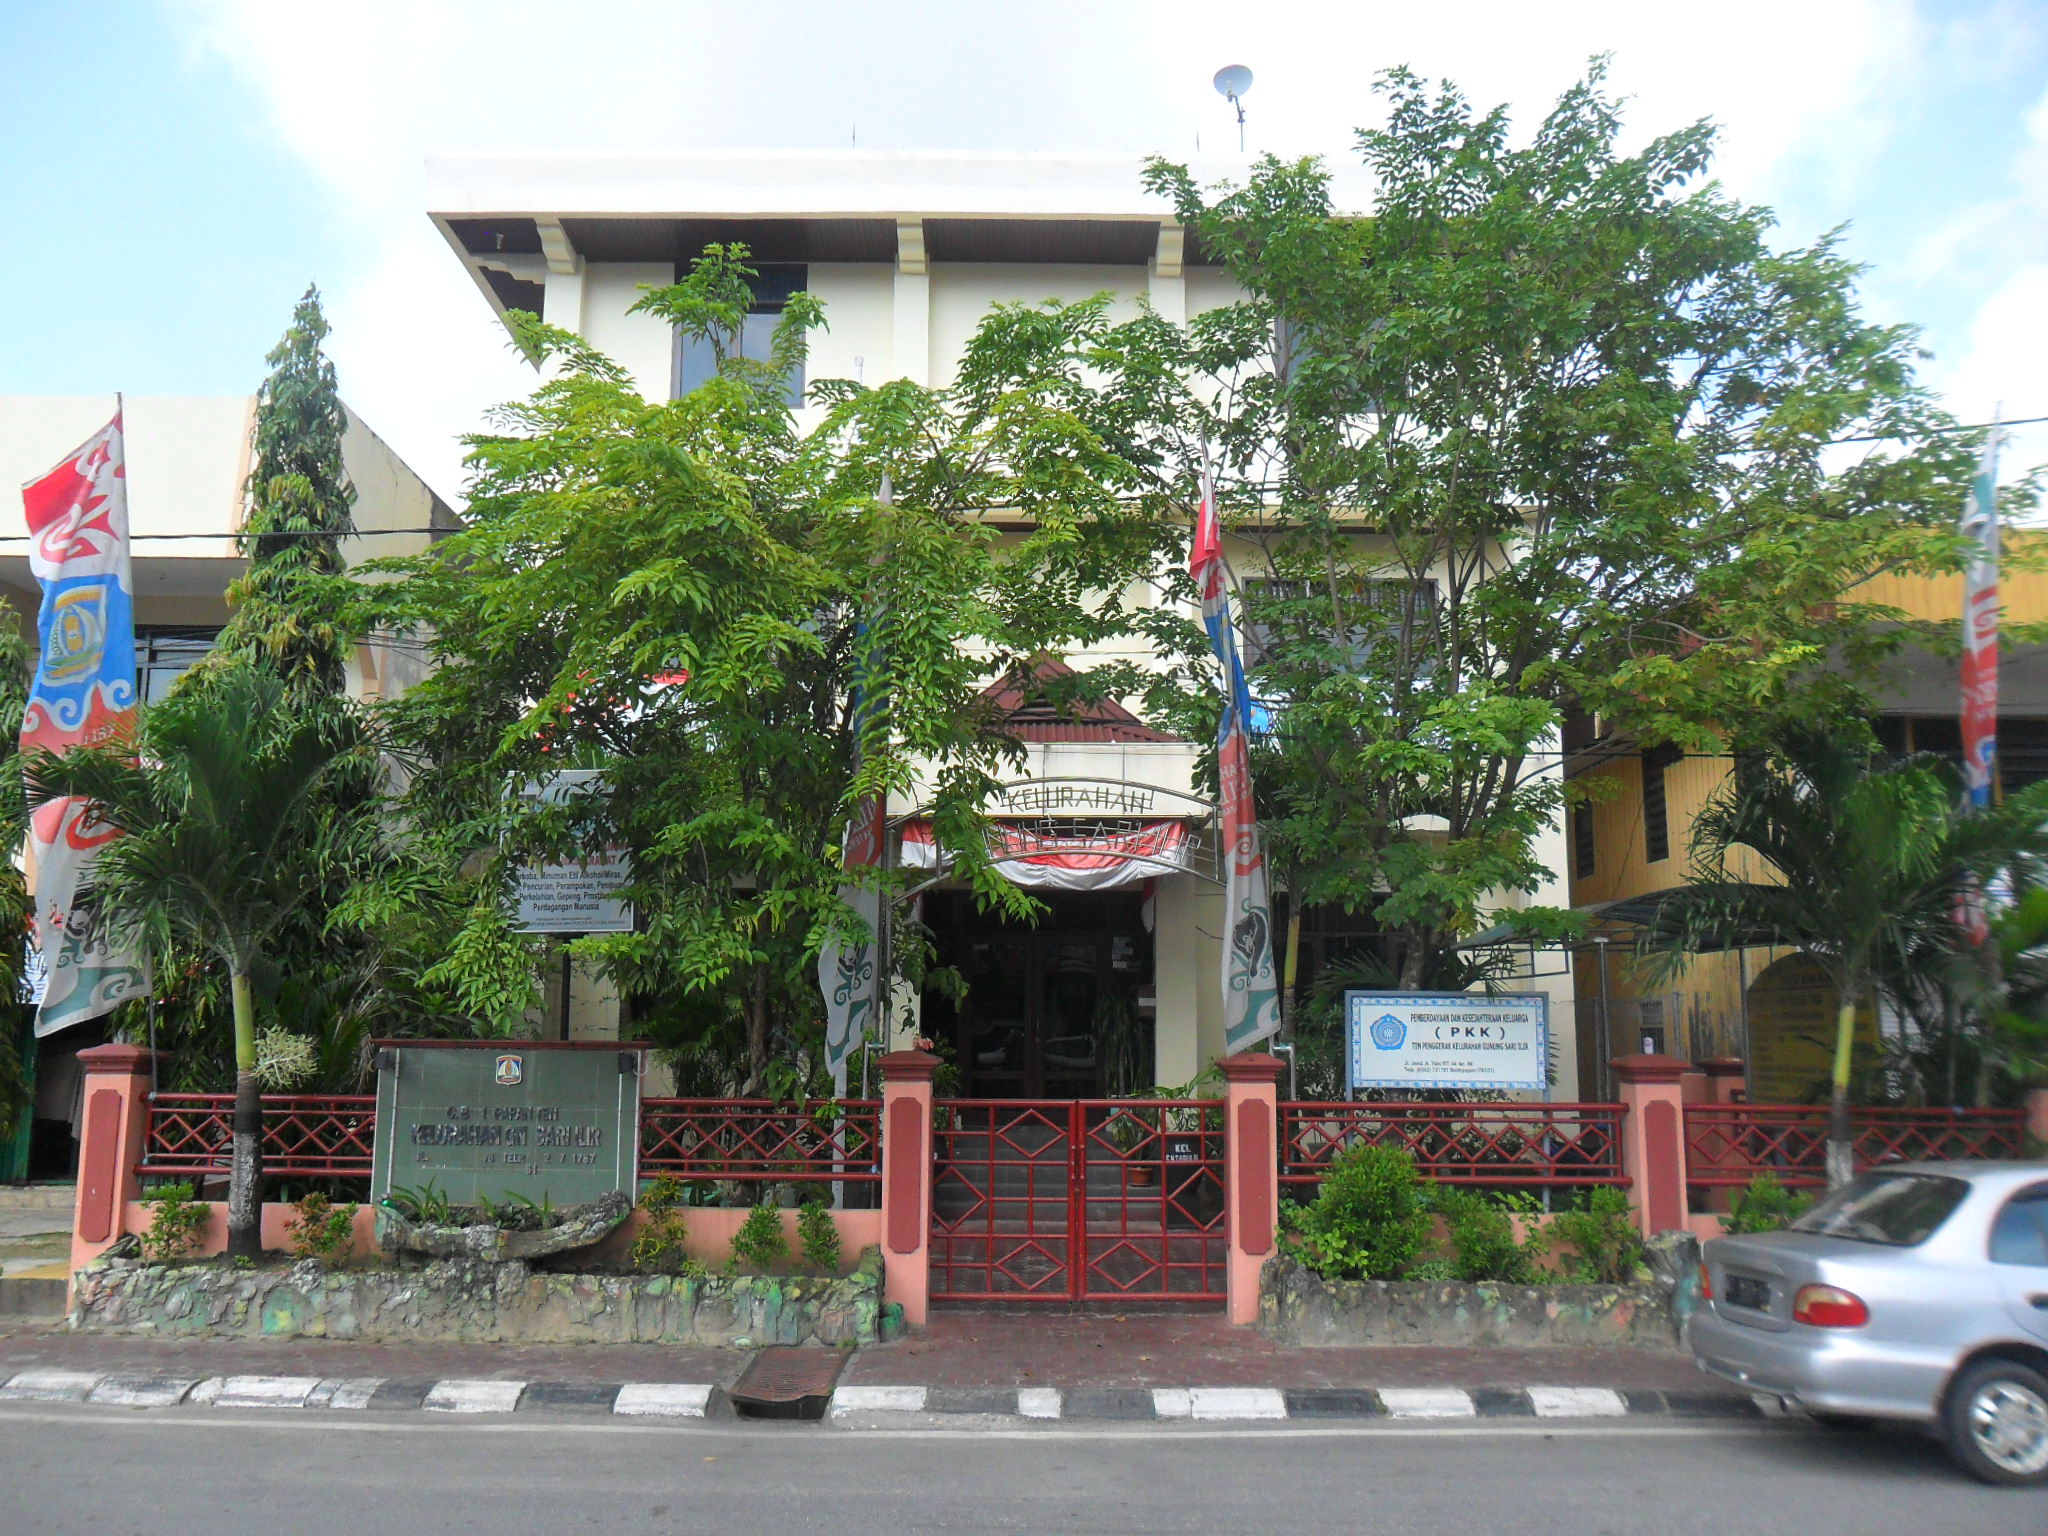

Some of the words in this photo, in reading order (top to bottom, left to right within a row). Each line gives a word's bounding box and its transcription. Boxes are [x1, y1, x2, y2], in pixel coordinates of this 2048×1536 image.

[1007, 786, 1145, 813] KELURAHAN
[533, 903, 573, 913] Perdagangan
[574, 902, 600, 911] Manusia
[1410, 1013, 1450, 1023] PEMBERDAYAAN
[1450, 1013, 1462, 1023] DAN
[1502, 1013, 1529, 1023] KELUARGA
[411, 1124, 500, 1146] KELURAHAN
[535, 1123, 571, 1147] SARI
[574, 1123, 601, 1147] ILIR
